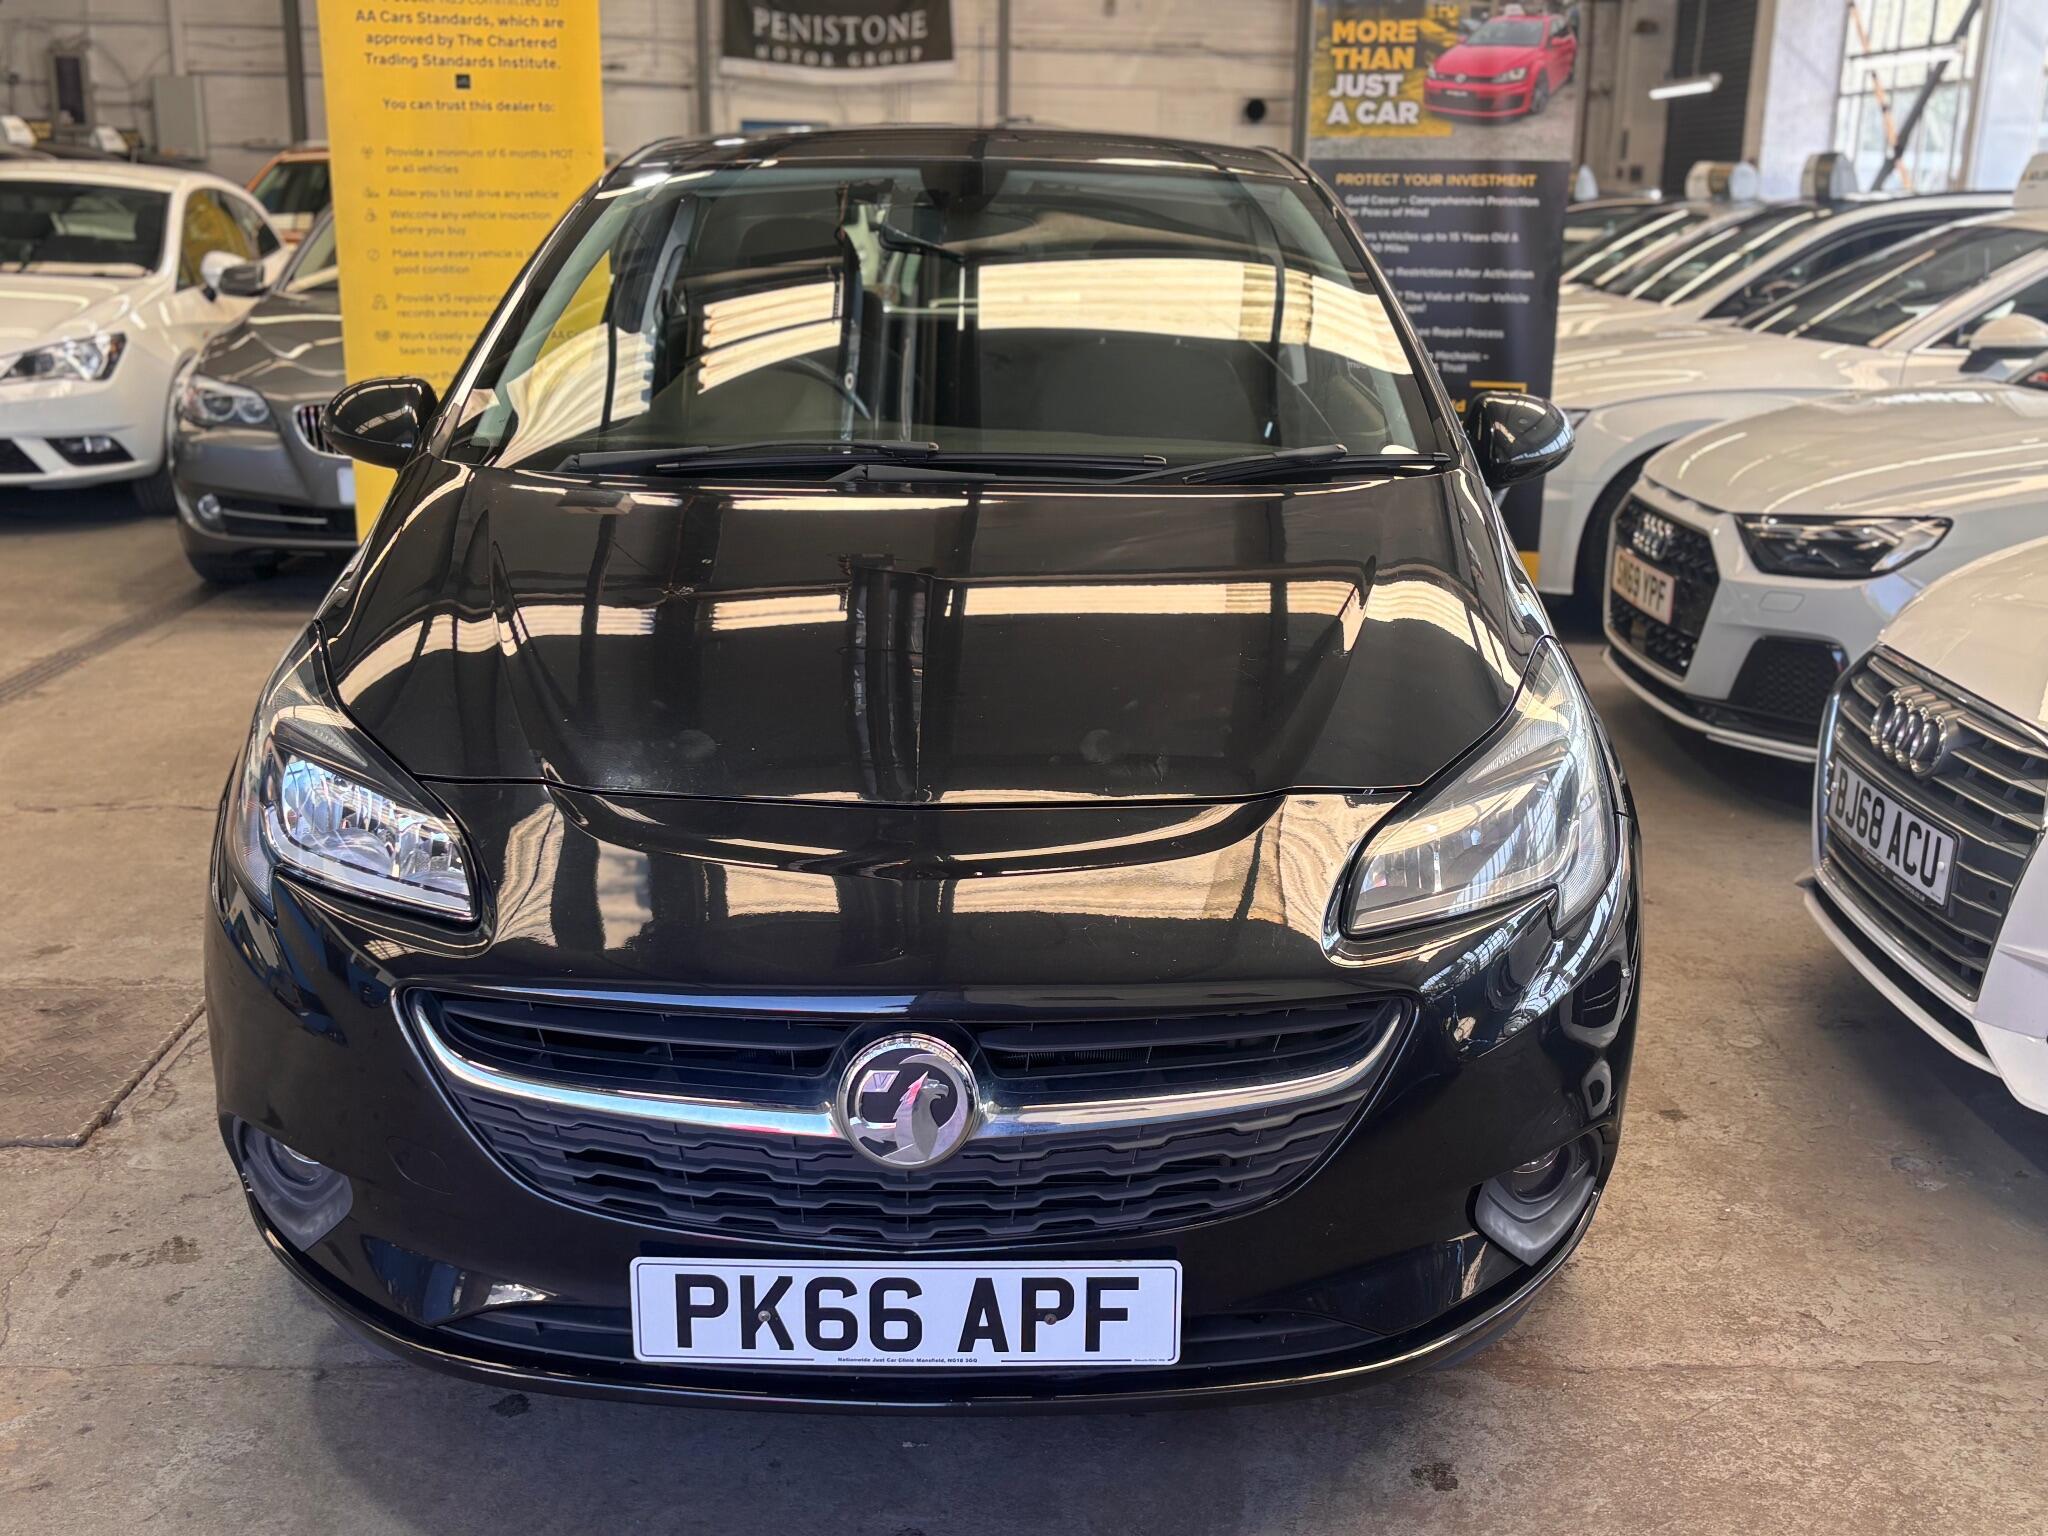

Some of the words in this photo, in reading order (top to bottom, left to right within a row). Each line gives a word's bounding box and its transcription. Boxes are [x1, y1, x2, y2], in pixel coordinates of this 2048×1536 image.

[356, 10, 376, 23] AA
[380, 10, 413, 24] Cars
[417, 12, 495, 28] Standards,
[498, 14, 539, 28] which
[543, 17, 565, 29] are
[752, 6, 928, 46] PENISTONE
[1332, 19, 1418, 44] MORE
[366, 34, 434, 47] approved
[438, 34, 454, 48] by
[458, 34, 483, 47] The
[487, 35, 557, 49] Chartered
[364, 52, 418, 68] Trading
[422, 54, 495, 68] Standards
[498, 55, 561, 70] Institute.
[1330, 46, 1415, 70] THAN
[1328, 73, 1404, 97] JUST
[383, 98, 406, 110] You
[410, 101, 433, 110] can
[436, 100, 466, 111] trust
[470, 100, 493, 111] this
[496, 100, 535, 112] dealer
[538, 101, 555, 112] to:
[1327, 100, 1350, 125] A
[1355, 100, 1419, 125] CAR
[385, 147, 425, 158] Provide
[436, 148, 483, 158] minimum
[487, 148, 497, 158] of
[509, 149, 547, 159] months
[549, 149, 574, 159] MOT
[386, 165, 399, 174] on
[402, 163, 415, 174] all
[417, 164, 459, 174] vehicles
[1335, 173, 1400, 186] PROTECT
[1403, 174, 1444, 187] YOUR
[1446, 173, 1538, 187] INVESTMENT
[388, 187, 417, 197] Allow
[419, 190, 437, 199] you
[439, 188, 450, 198] to
[453, 188, 473, 198] test
[476, 188, 500, 198] drive
[503, 190, 521, 200] any
[523, 189, 560, 199] vehicle
[1345, 195, 1369, 206] Gold
[1371, 195, 1400, 206] Cover
[1409, 195, 1485, 208] Comprehensive
[1487, 196, 1540, 208] Protection
[390, 209, 438, 220] Welcome
[441, 211, 459, 221] any
[461, 209, 496, 220] vehicle
[500, 210, 551, 221] inspection
[1361, 207, 1390, 217] Peace
[1391, 207, 1403, 217] of
[1404, 207, 1430, 217] Mind
[390, 225, 424, 235] before
[426, 227, 445, 237] you
[448, 226, 466, 237] buy
[1378, 231, 1419, 242] Vehicles
[1421, 233, 1435, 244] up
[1436, 233, 1447, 242] to
[1462, 232, 1489, 243] Years
[1491, 232, 1508, 243] Old
[392, 249, 420, 259] Make
[422, 251, 445, 259] sure
[447, 251, 474, 260] every
[477, 250, 512, 259] vehicle
[1384, 244, 1410, 254] Miles
[393, 265, 420, 275] good
[422, 265, 471, 275] condition
[1396, 267, 1454, 278] Restrictions
[1455, 268, 1481, 279] After
[1482, 268, 1535, 280] Activation
[454, 294, 499, 304] registrat
[1404, 291, 1422, 301] The
[1425, 290, 1452, 302] Value
[1454, 292, 1466, 302] of
[1467, 292, 1491, 303] Your
[1492, 292, 1531, 303] Vehicle
[397, 310, 436, 318] records
[439, 310, 469, 318] where
[399, 331, 426, 340] Work
[428, 331, 464, 342] closely
[1432, 327, 1463, 338] Repair
[1465, 327, 1504, 338] Process
[1435, 350, 1481, 361] Mechanic
[1441, 363, 1467, 373] Trust
[1643, 573, 1667, 612] YPF
[1835, 767, 1885, 849] BJ68
[1886, 811, 1942, 888] ACU
[674, 1273, 923, 1353] PK66
[957, 1276, 1140, 1354] APF
